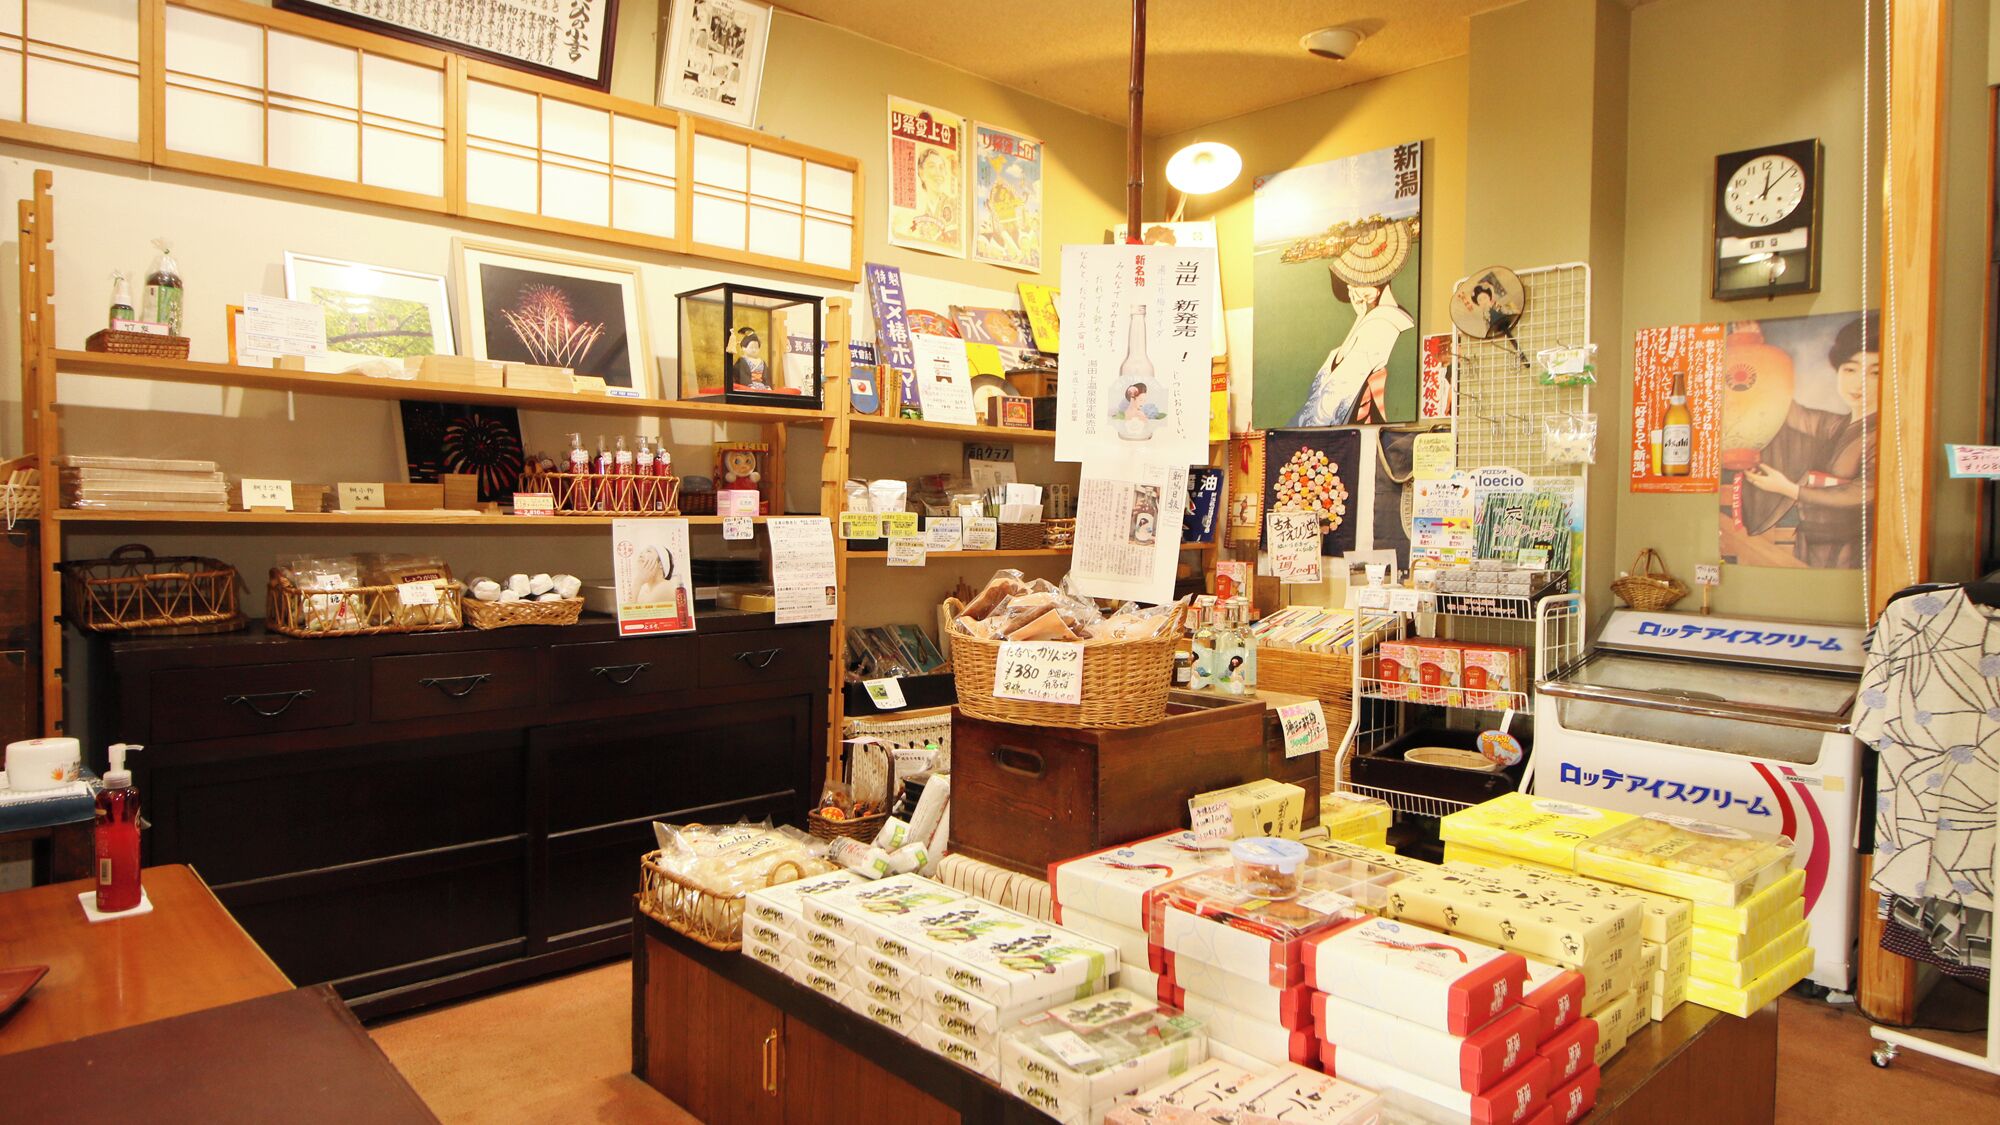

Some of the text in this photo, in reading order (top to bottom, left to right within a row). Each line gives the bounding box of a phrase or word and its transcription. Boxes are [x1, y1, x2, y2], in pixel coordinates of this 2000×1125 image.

[1394, 142, 1418, 199] 新潟
[1762, 160, 1773, 169] 12
[1735, 178, 1747, 189] 10
[1730, 192, 1739, 201] 9
[1746, 212, 1754, 223] 7
[1760, 214, 1769, 223] 6
[874, 269, 899, 287] 特製
[1135, 254, 1146, 287] 新名物
[1174, 261, 1199, 287] 当世
[1172, 298, 1199, 338] 新発売
[1664, 438, 1689, 448] Asahi
[1200, 474, 1218, 491] 油
[1503, 505, 1523, 522] 炭
[1637, 621, 1844, 652] ロッテアイスクリーム
[1005, 660, 1040, 680] ¥380
[1559, 761, 1773, 817] ロッテアイスクリーム
